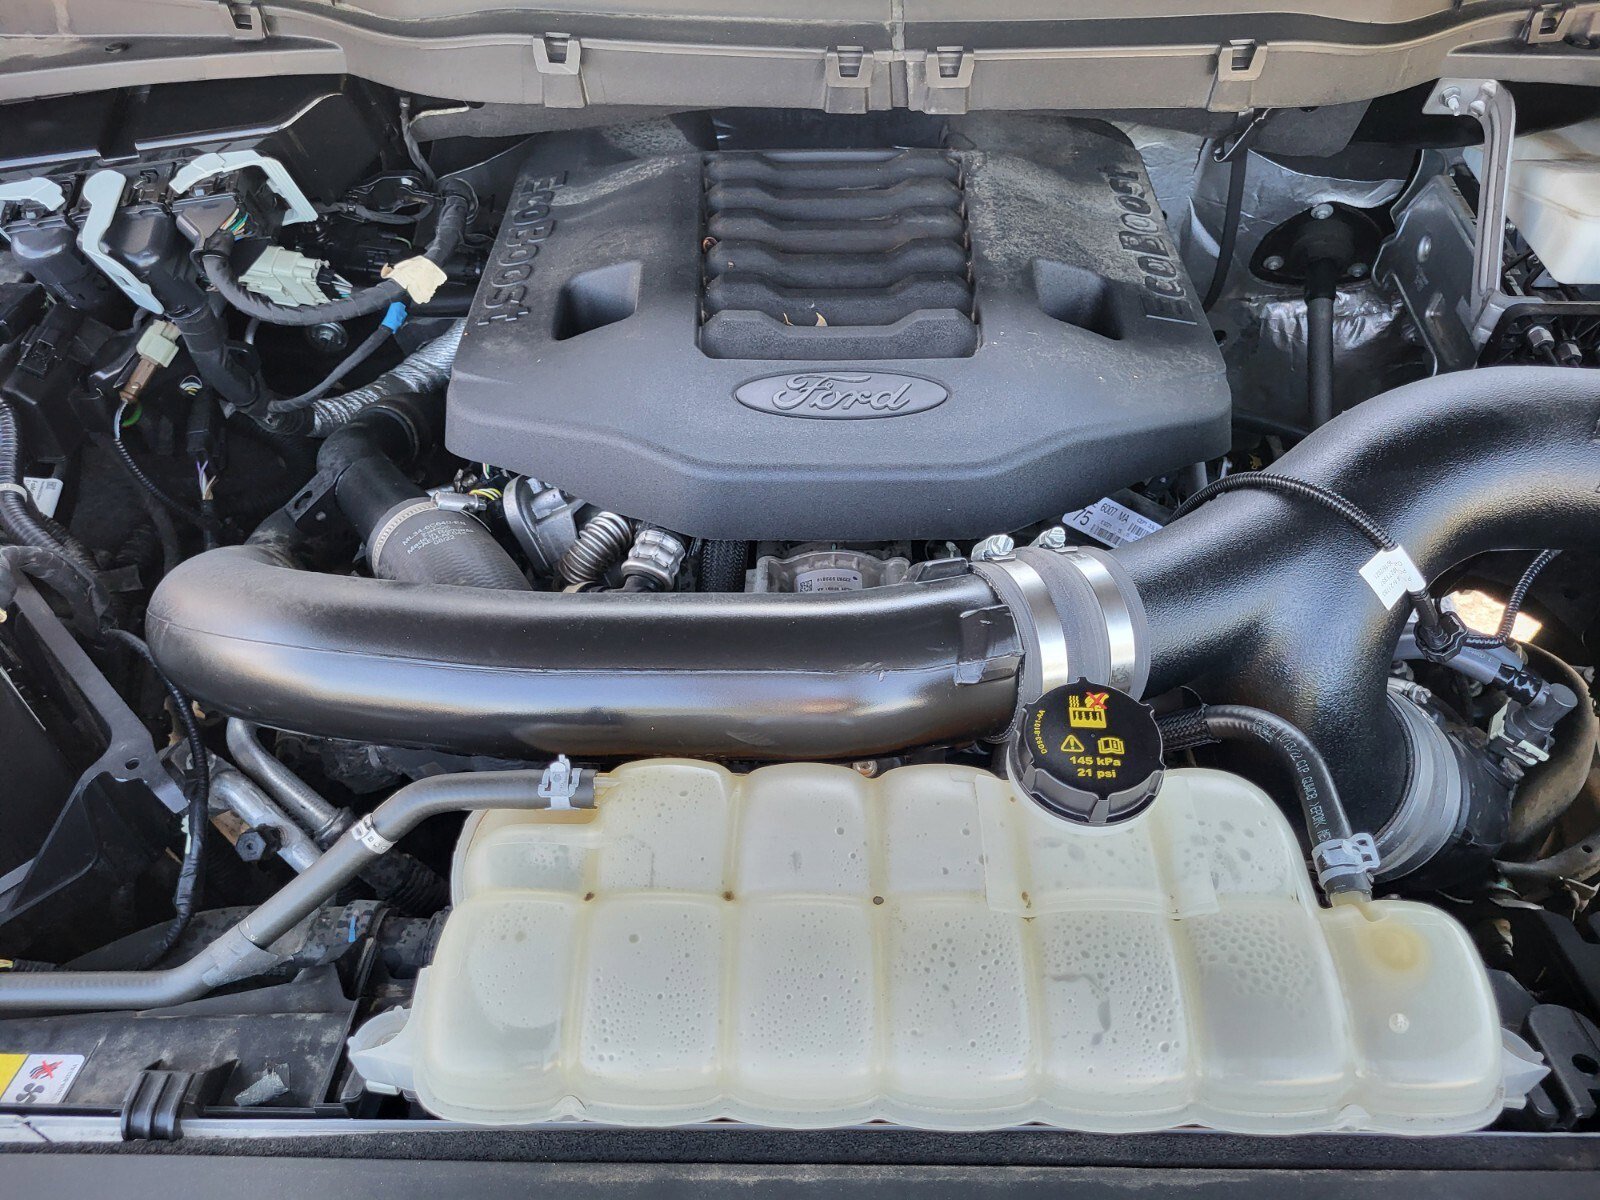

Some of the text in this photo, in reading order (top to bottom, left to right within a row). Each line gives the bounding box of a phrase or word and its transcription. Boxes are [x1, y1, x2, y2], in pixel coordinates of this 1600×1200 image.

[771, 374, 914, 411] Ford
[1100, 502, 1118, 517] 6007
[1069, 756, 1121, 767] 145 kPa
[1077, 768, 1117, 779] 21 psi
